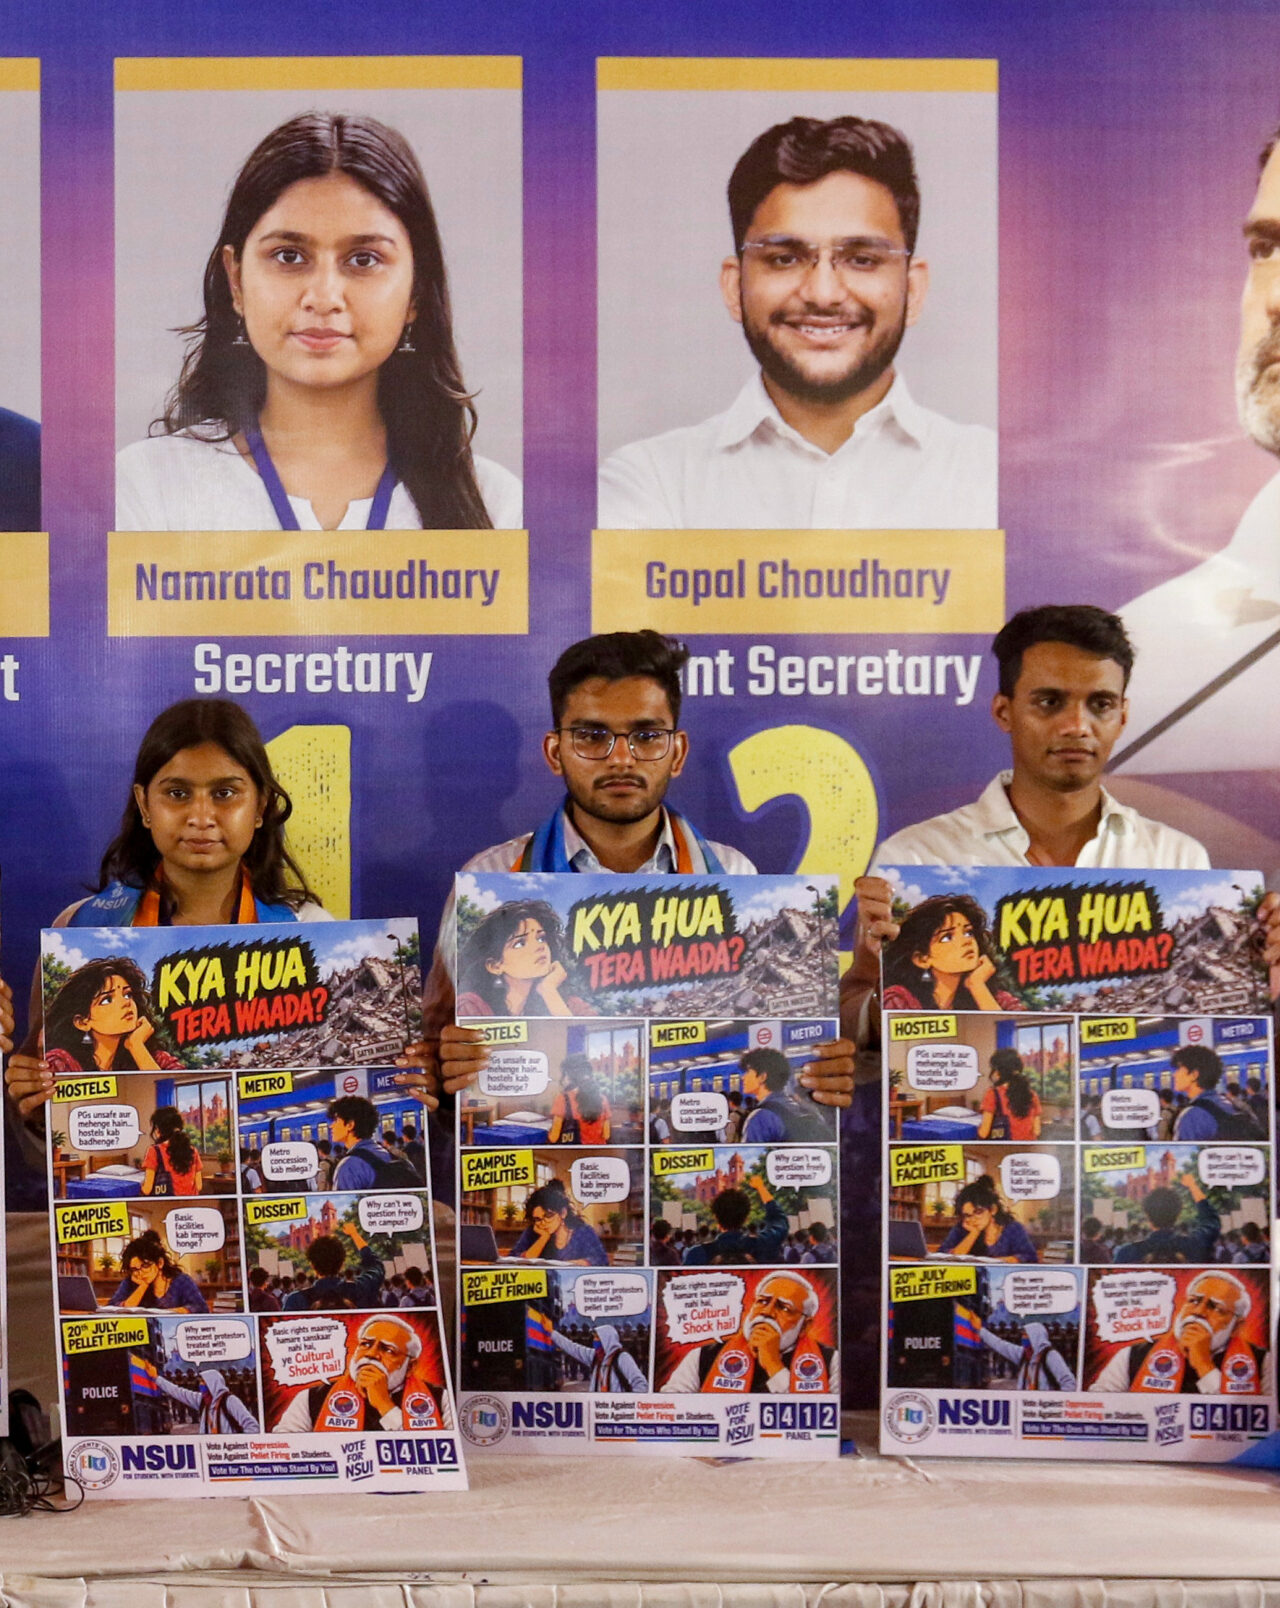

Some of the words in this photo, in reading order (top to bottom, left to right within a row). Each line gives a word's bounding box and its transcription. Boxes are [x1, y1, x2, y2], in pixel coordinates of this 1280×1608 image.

[135, 563, 291, 601] Namrata
[303, 559, 500, 606] Chaudhary
[646, 559, 746, 606] Gopal
[758, 558, 951, 606] Choudhary
[194, 643, 433, 703] Secretary
[747, 645, 982, 706] Secretary
[92, 897, 129, 910] NSUI
[574, 903, 641, 953] KYA
[651, 895, 723, 945] HUA
[1001, 898, 1068, 948] KYA
[1078, 892, 1151, 941] HUA
[585, 951, 646, 989] TERA
[650, 936, 745, 980] WAADA?
[1012, 947, 1074, 984] TERA
[1078, 933, 1173, 976] WAADA?
[160, 958, 225, 1008] KYA
[235, 947, 306, 998] HUA
[171, 1004, 232, 1043] TERA
[235, 987, 328, 1033] WAADA?
[483, 1026, 520, 1042] STELS
[657, 1026, 698, 1042] METRO
[791, 1025, 823, 1040] METRO
[895, 1019, 949, 1036] HOSTELS
[1088, 1022, 1129, 1038] METRO
[57, 1080, 110, 1099] HOSTELS
[245, 1077, 285, 1094] METRO
[467, 1154, 516, 1172] CAMPUS
[660, 1153, 708, 1170] DISSENT
[896, 1149, 945, 1166] CAMPUS
[1092, 1150, 1140, 1167] DISSENT
[468, 1167, 529, 1187] FACILITIES
[896, 1162, 958, 1182] FACILITIES
[62, 1206, 111, 1224] CAMPUS
[253, 1201, 301, 1219] DISSENT
[63, 1219, 124, 1239] FACILITIES
[491, 1272, 518, 1286] JULY
[919, 1268, 947, 1282] JULY
[468, 1287, 503, 1302] PELLET
[506, 1282, 544, 1299] FIRING
[895, 1283, 931, 1298] PELLET
[935, 1279, 973, 1295] FIRING
[92, 1321, 119, 1334] JULY
[68, 1335, 104, 1350] PELLET
[108, 1330, 147, 1346] FIRING
[478, 1340, 513, 1353] POLICE
[905, 1337, 941, 1349] POLICE
[294, 1349, 334, 1364] Cultural
[289, 1365, 319, 1378] Shock
[322, 1360, 341, 1372] hai!
[82, 1386, 118, 1399] POLICE
[512, 1401, 583, 1428] NSUI
[725, 1401, 751, 1417] VOTE
[938, 1399, 1010, 1426] NSUI
[729, 1414, 746, 1427] FOR
[726, 1424, 755, 1443] NSUI
[121, 1444, 196, 1471] NSUI
[406, 1466, 435, 1476] PANEL
